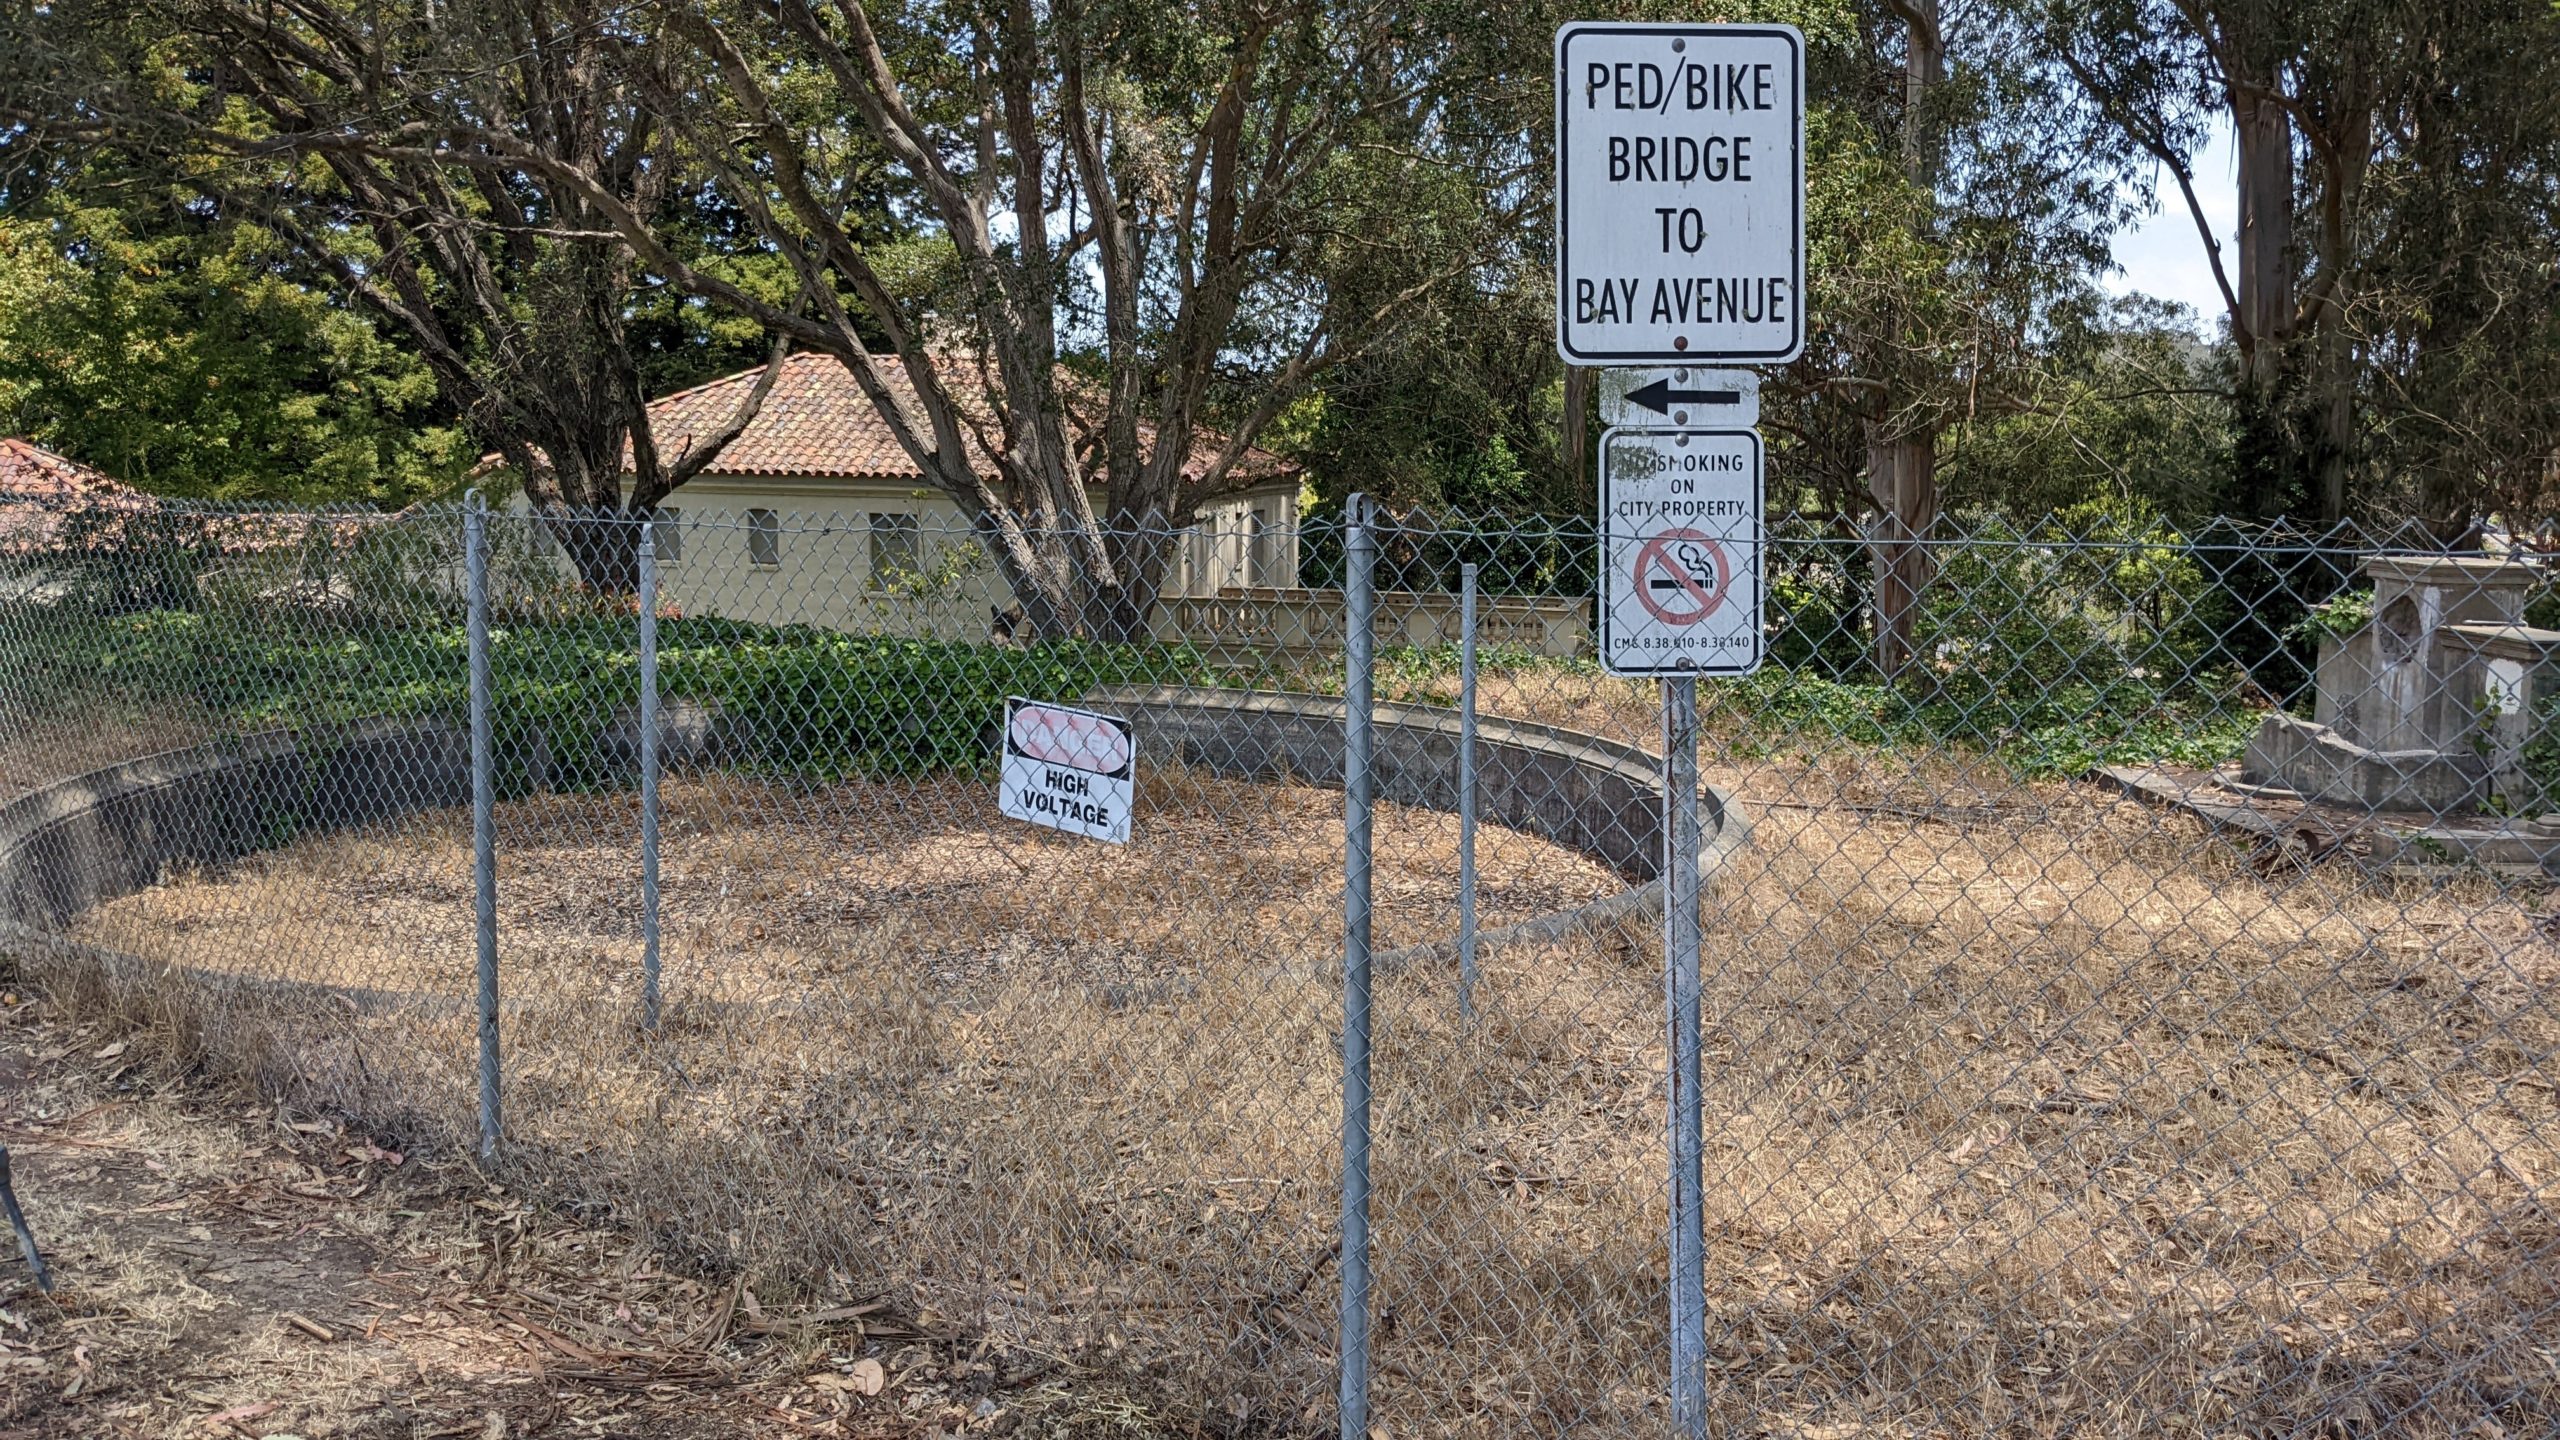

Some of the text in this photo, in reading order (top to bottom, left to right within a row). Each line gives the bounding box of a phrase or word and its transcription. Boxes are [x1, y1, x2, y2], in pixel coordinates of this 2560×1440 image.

[1587, 56, 1773, 115] PED/BIKE
[1609, 136, 1752, 181] BRIDGE
[1655, 207, 1703, 253] TO
[1576, 277, 1785, 324] BAY AVENUE
[1657, 454, 1743, 472] SMOKING
[1671, 479, 1694, 494] ON
[1619, 500, 1745, 517] CITY PROPERTY
[1045, 769, 1089, 797] HIGH
[1024, 789, 1109, 827] VOLTAGE
